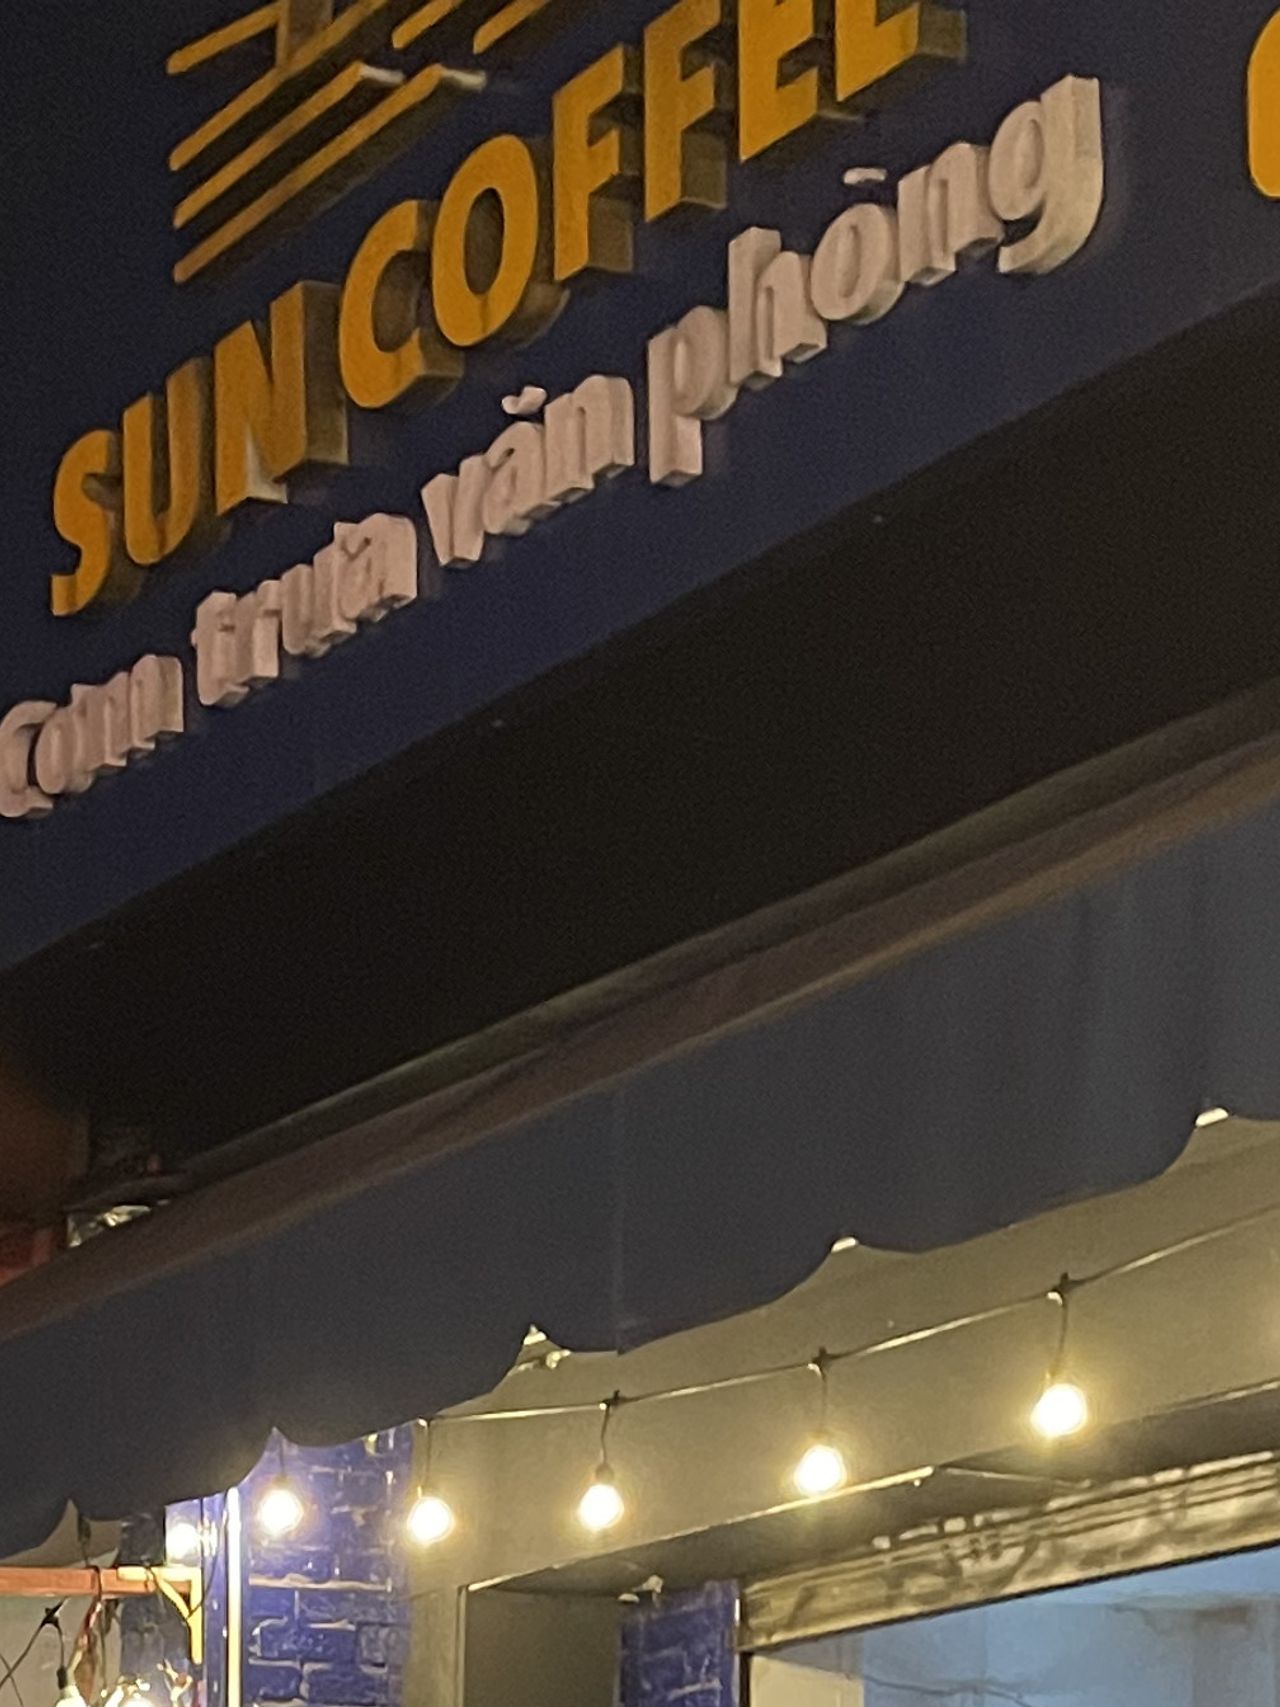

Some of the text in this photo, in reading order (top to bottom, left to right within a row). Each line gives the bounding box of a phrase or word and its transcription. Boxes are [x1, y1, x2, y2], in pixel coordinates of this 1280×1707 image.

[51, 283, 325, 617] SUN
[190, 512, 418, 706] trưa
[421, 384, 636, 566] văn
